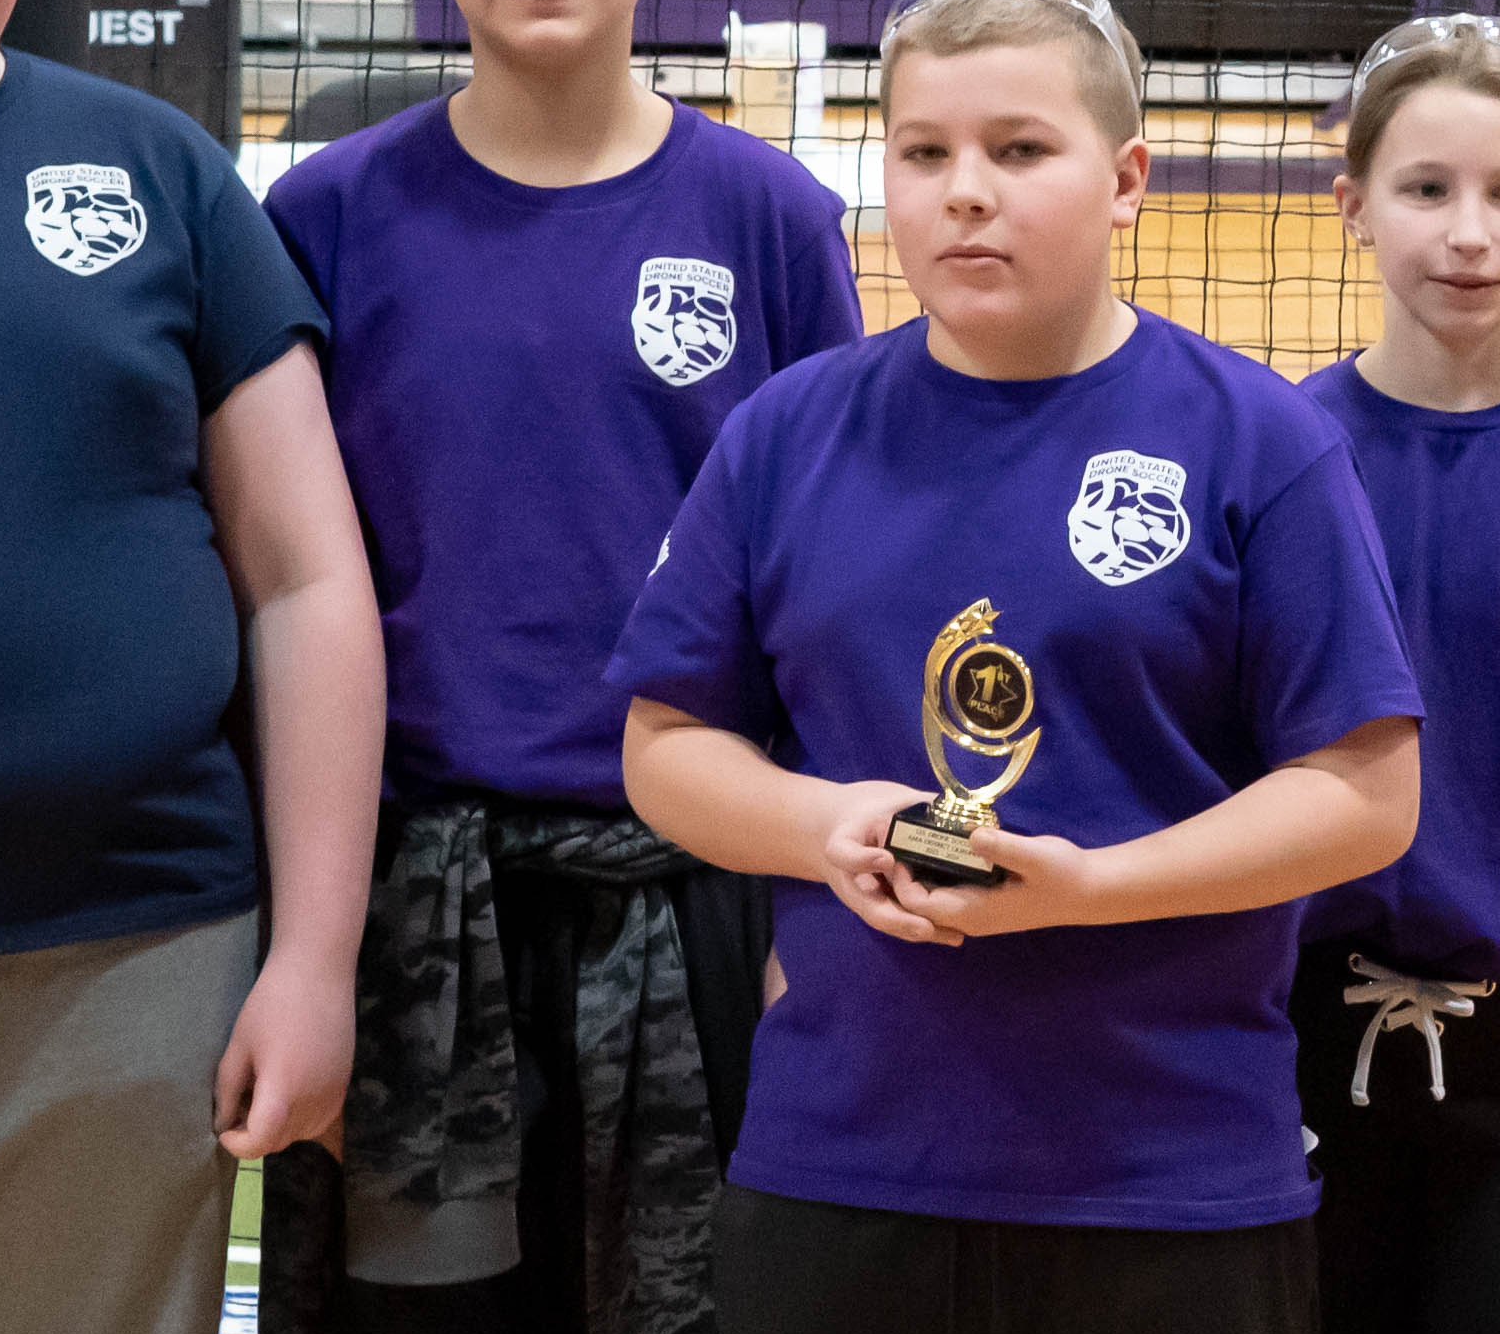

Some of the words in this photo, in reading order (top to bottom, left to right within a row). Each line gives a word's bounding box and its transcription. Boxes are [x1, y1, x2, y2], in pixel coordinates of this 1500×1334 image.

[644, 272, 684, 282] DRONE
[687, 273, 729, 293] SOCCER
[646, 262, 688, 273] UNITED
[691, 264, 731, 283] STATES
[1089, 465, 1129, 479] DRONE
[1132, 468, 1179, 488] SOCCER
[1091, 455, 1136, 469] UNITED
[1139, 461, 1180, 480] STATES
